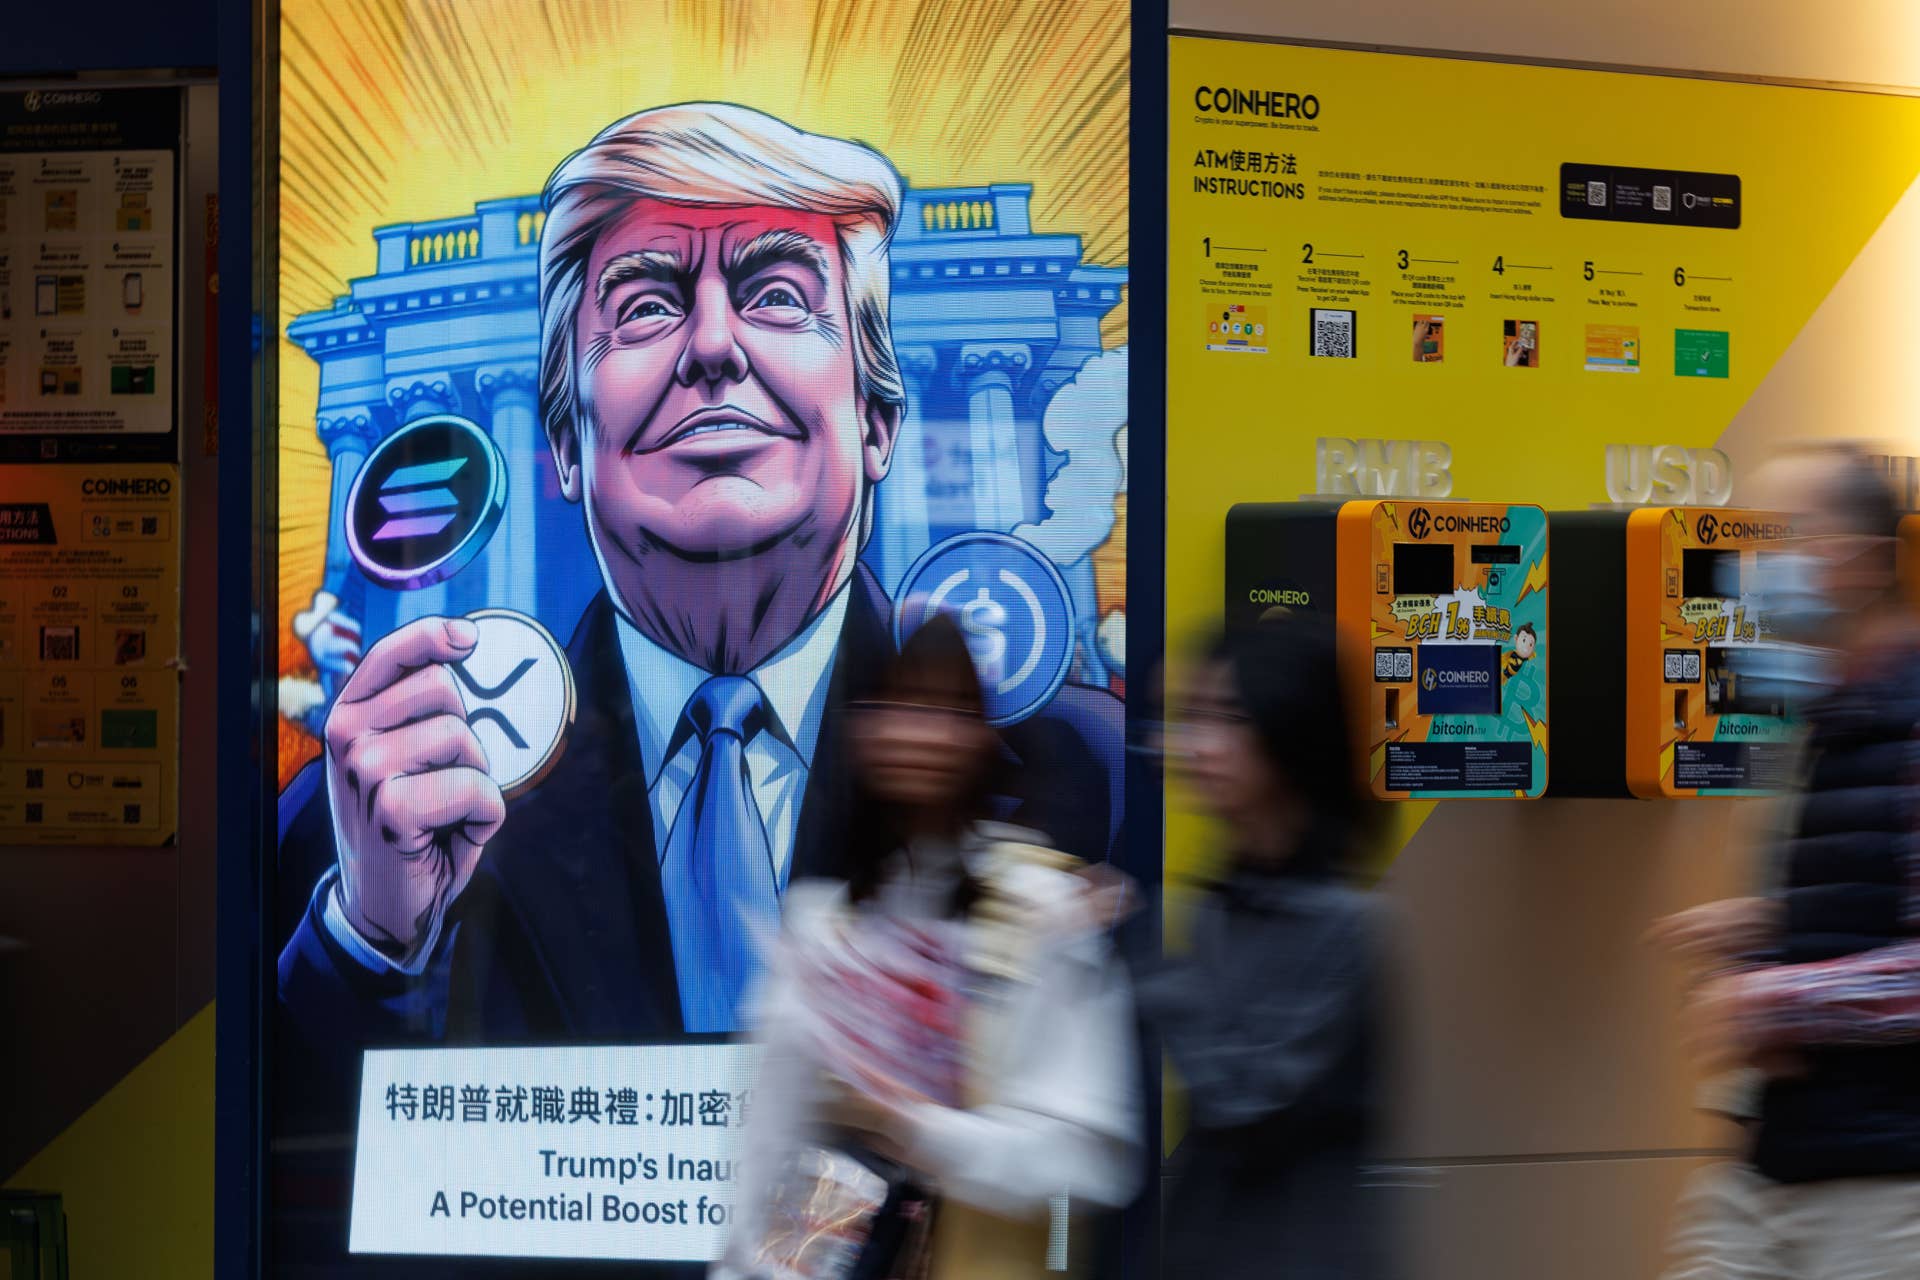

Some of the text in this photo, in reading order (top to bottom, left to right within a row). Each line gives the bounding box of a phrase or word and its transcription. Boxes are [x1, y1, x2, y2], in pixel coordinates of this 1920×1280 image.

[1195, 86, 1320, 120] COINHERO
[1194, 149, 1297, 175] ATM使用方法
[1194, 176, 1304, 200] INSTRUCTIONS
[1203, 237, 1210, 257] 1
[1302, 243, 1313, 264] 2
[1398, 249, 1409, 270] 3
[1493, 256, 1505, 275] 4
[1584, 261, 1594, 281] 5
[1674, 267, 1686, 286] 6
[1315, 437, 1453, 498] RMB
[1605, 443, 1732, 506] USD
[81, 479, 170, 495] COINHERO
[1434, 515, 1511, 534] COINHERO
[1721, 521, 1795, 540] COINHERO
[1248, 588, 1310, 606] COINHERO
[1405, 612, 1442, 640] BCH
[1694, 616, 1729, 643] BCH
[1439, 670, 1490, 683] COINHERO
[1432, 720, 1474, 735] bitcoin
[1719, 721, 1758, 735] bitcoin
[539, 1149, 732, 1185] Trump's Inau
[430, 1191, 451, 1218] A
[461, 1192, 592, 1222] Potential
[602, 1195, 688, 1225] Boost
